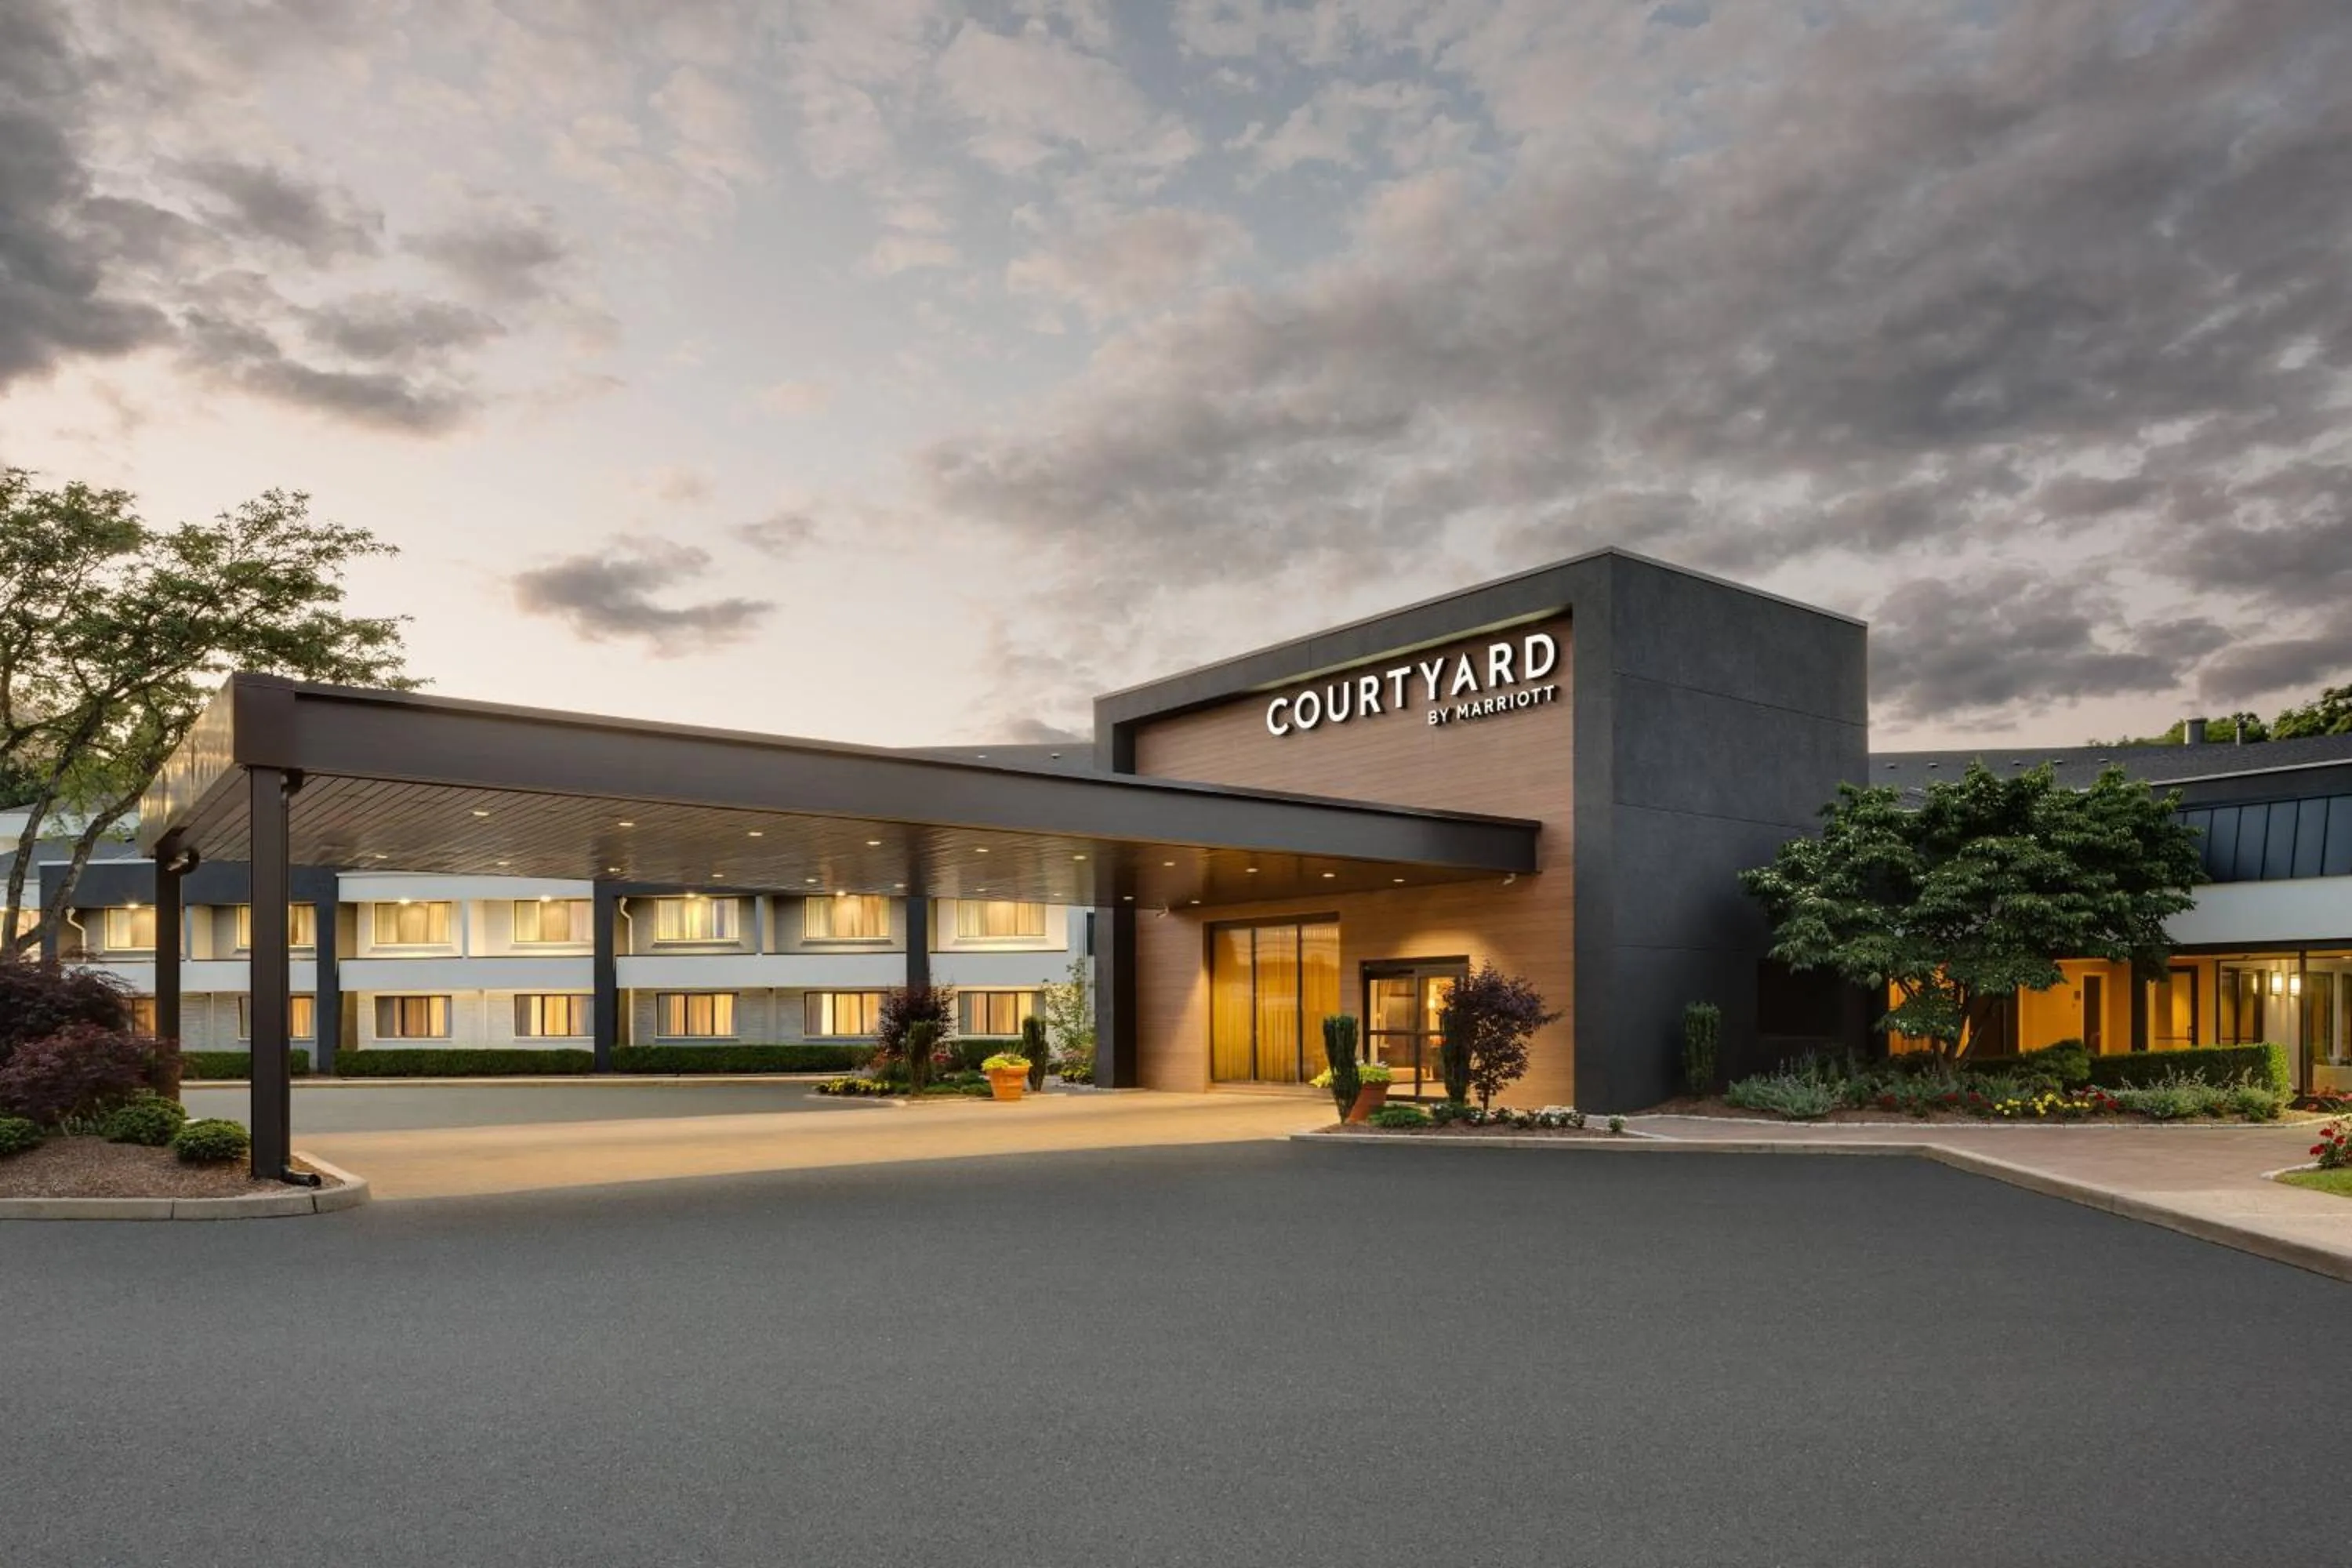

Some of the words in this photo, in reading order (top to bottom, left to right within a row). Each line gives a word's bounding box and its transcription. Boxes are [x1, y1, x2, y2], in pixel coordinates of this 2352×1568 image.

[1266, 633, 1555, 737] COURTYARD
[1428, 707, 1449, 725] BY
[1456, 684, 1555, 720] MARRIOTT
